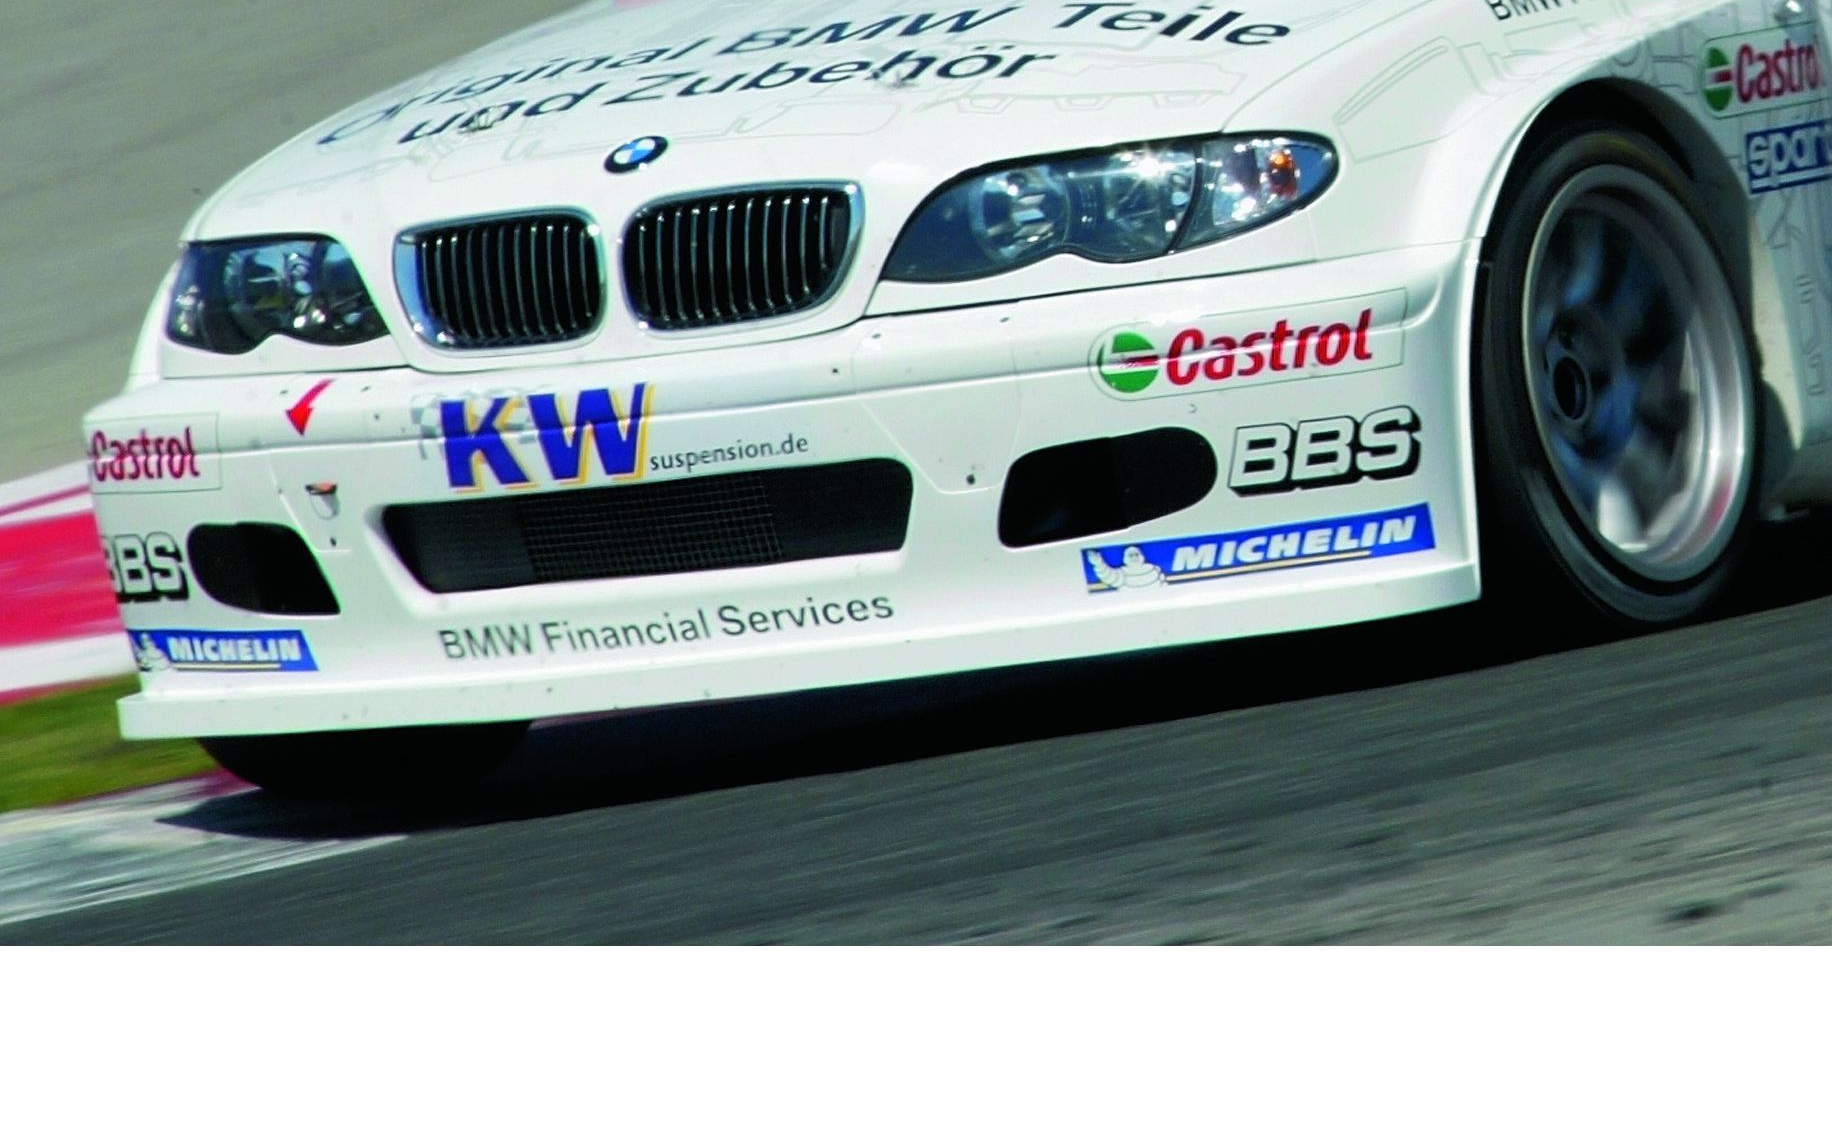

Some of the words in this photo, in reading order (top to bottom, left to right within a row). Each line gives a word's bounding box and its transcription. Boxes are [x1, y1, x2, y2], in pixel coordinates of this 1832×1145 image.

[316, 37, 712, 145] Original
[716, 5, 1020, 54] BMW
[1054, 2, 1291, 46] Teile
[398, 82, 605, 144] und
[603, 40, 1056, 106] Zubehör
[1737, 37, 1828, 104] Castro
[1166, 308, 1374, 386] Castrol
[89, 426, 200, 482] Castrol
[440, 382, 656, 493] KW
[650, 434, 809, 473] suspension.de
[1227, 405, 1421, 497] BBS
[1171, 515, 1416, 574] MICHELIN
[166, 636, 301, 663] MICHELIN
[438, 622, 534, 659] BMW
[541, 608, 711, 654] Financial
[720, 594, 895, 638] Services
